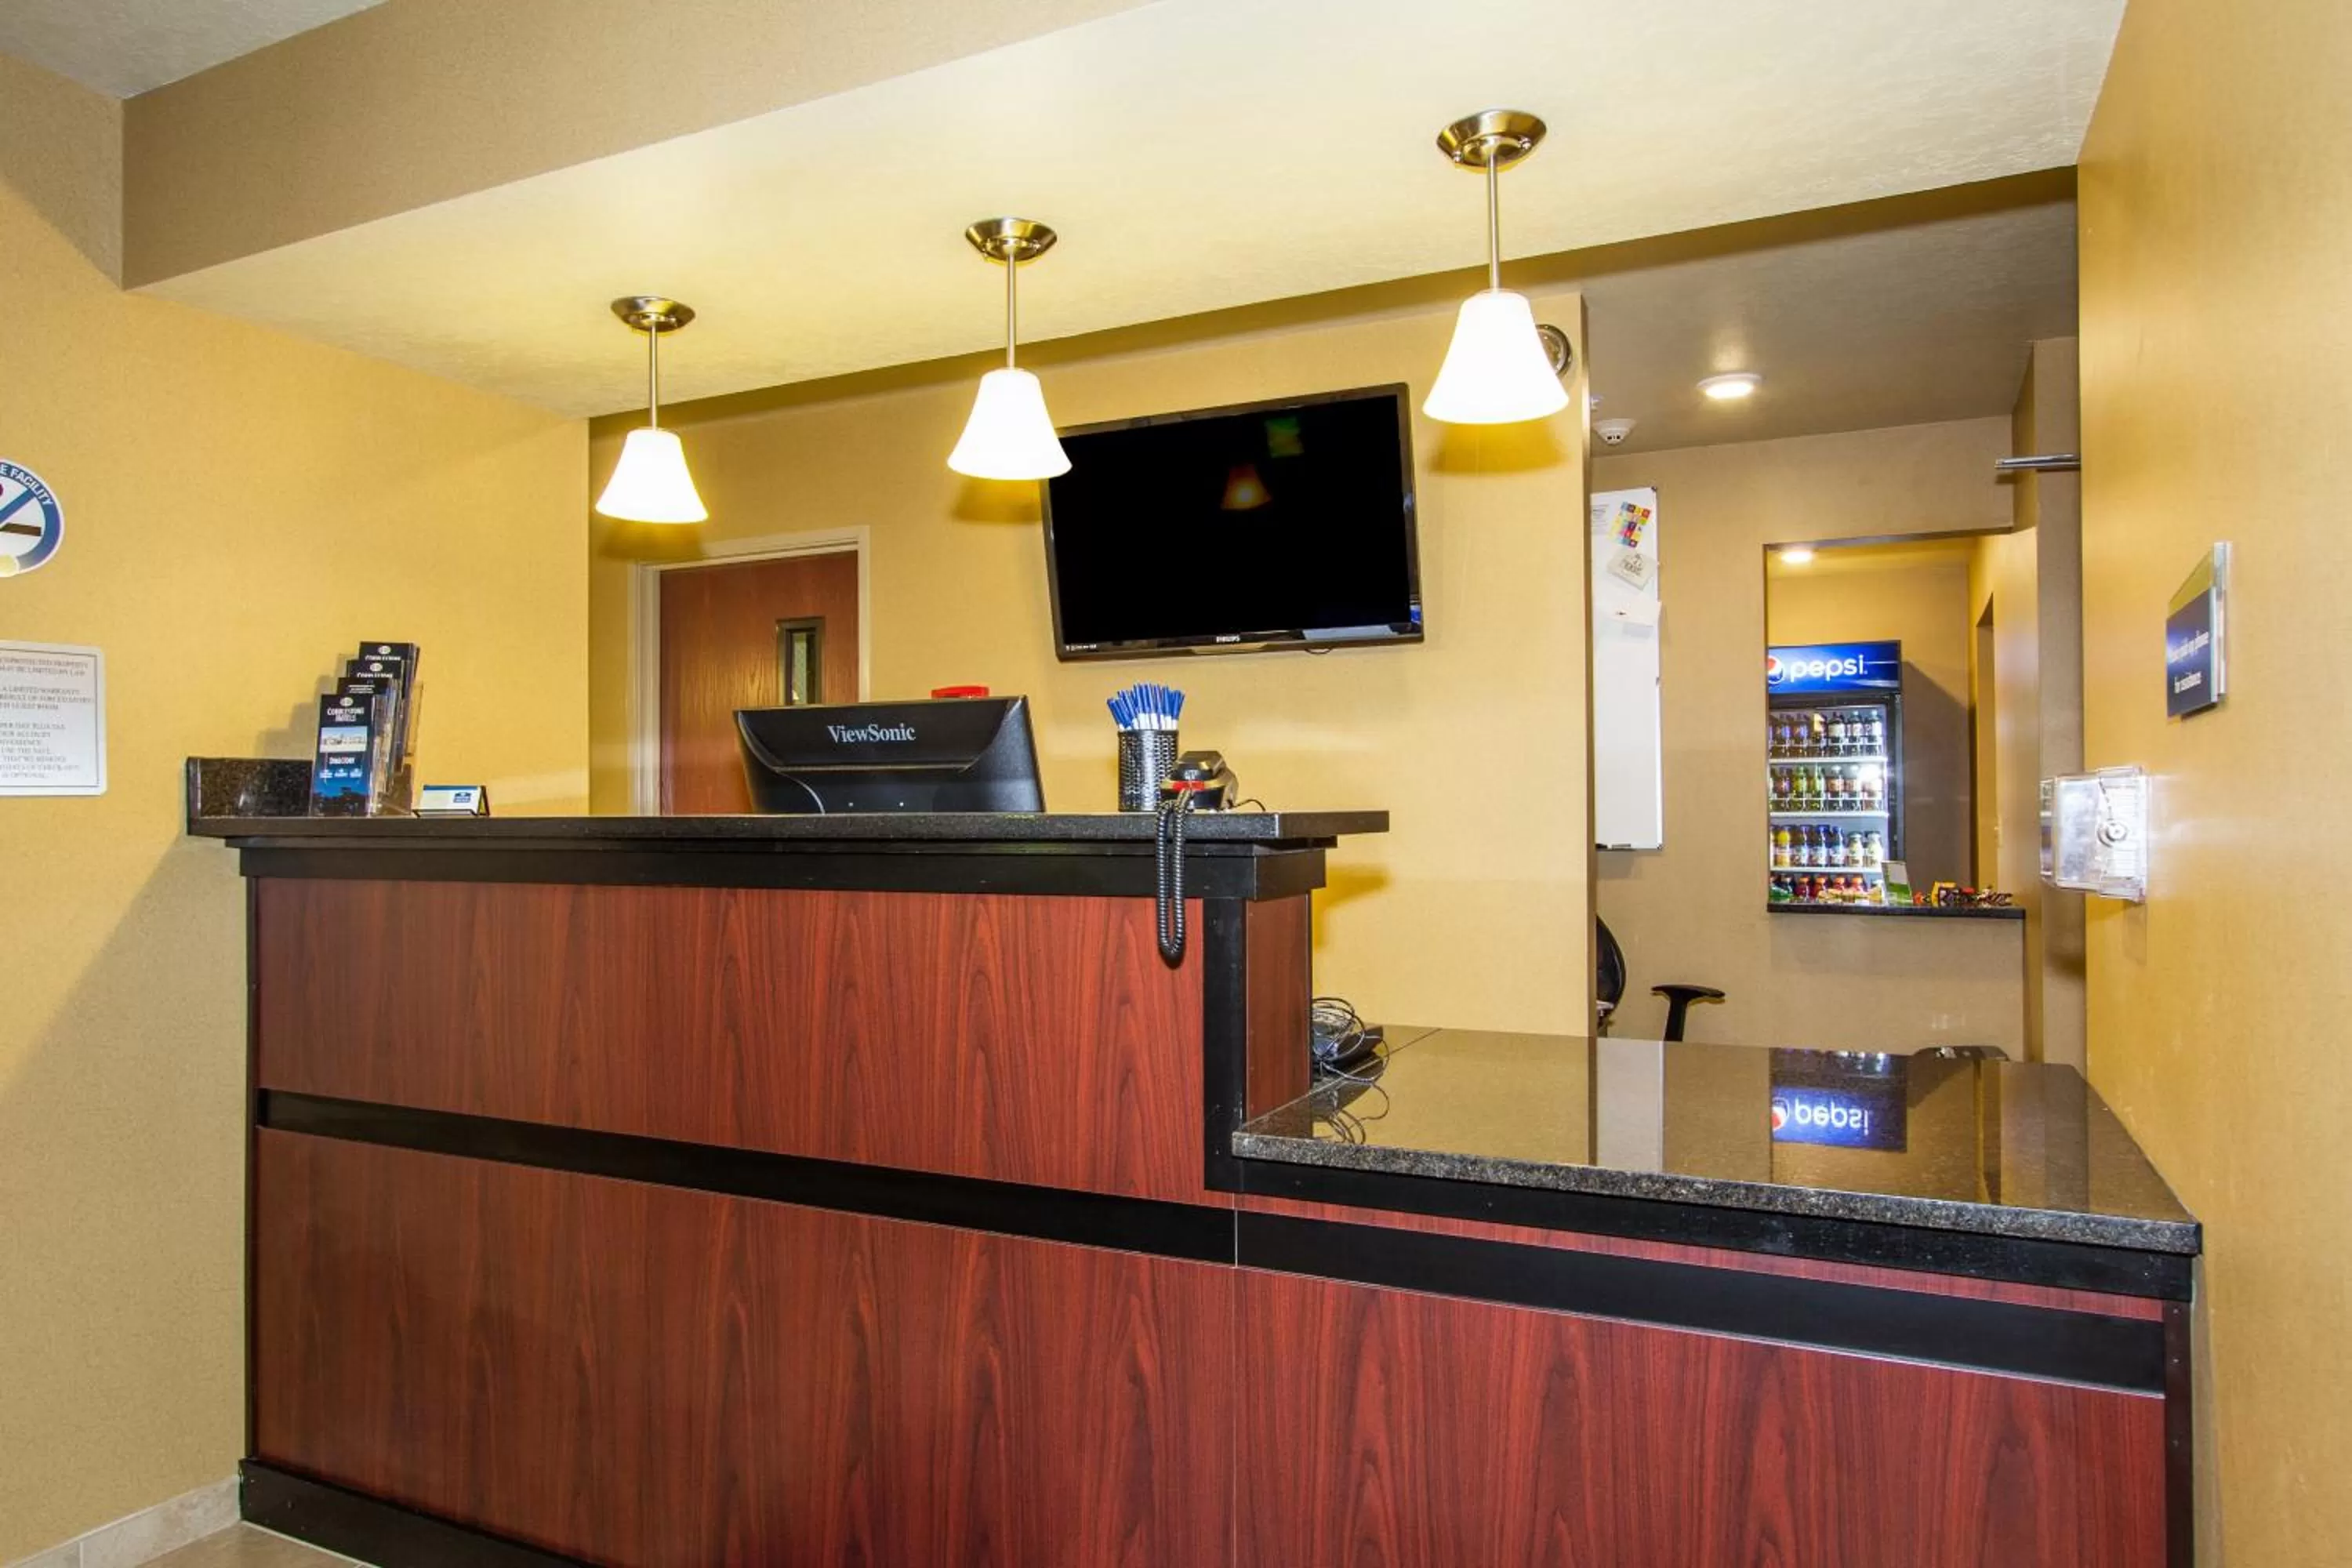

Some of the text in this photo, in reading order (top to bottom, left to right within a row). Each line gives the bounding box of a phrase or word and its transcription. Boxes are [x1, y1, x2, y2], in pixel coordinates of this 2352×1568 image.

[10, 467, 54, 505] FACILITY
[1790, 654, 1864, 683] pepsi
[827, 722, 916, 743] ViewSonic
